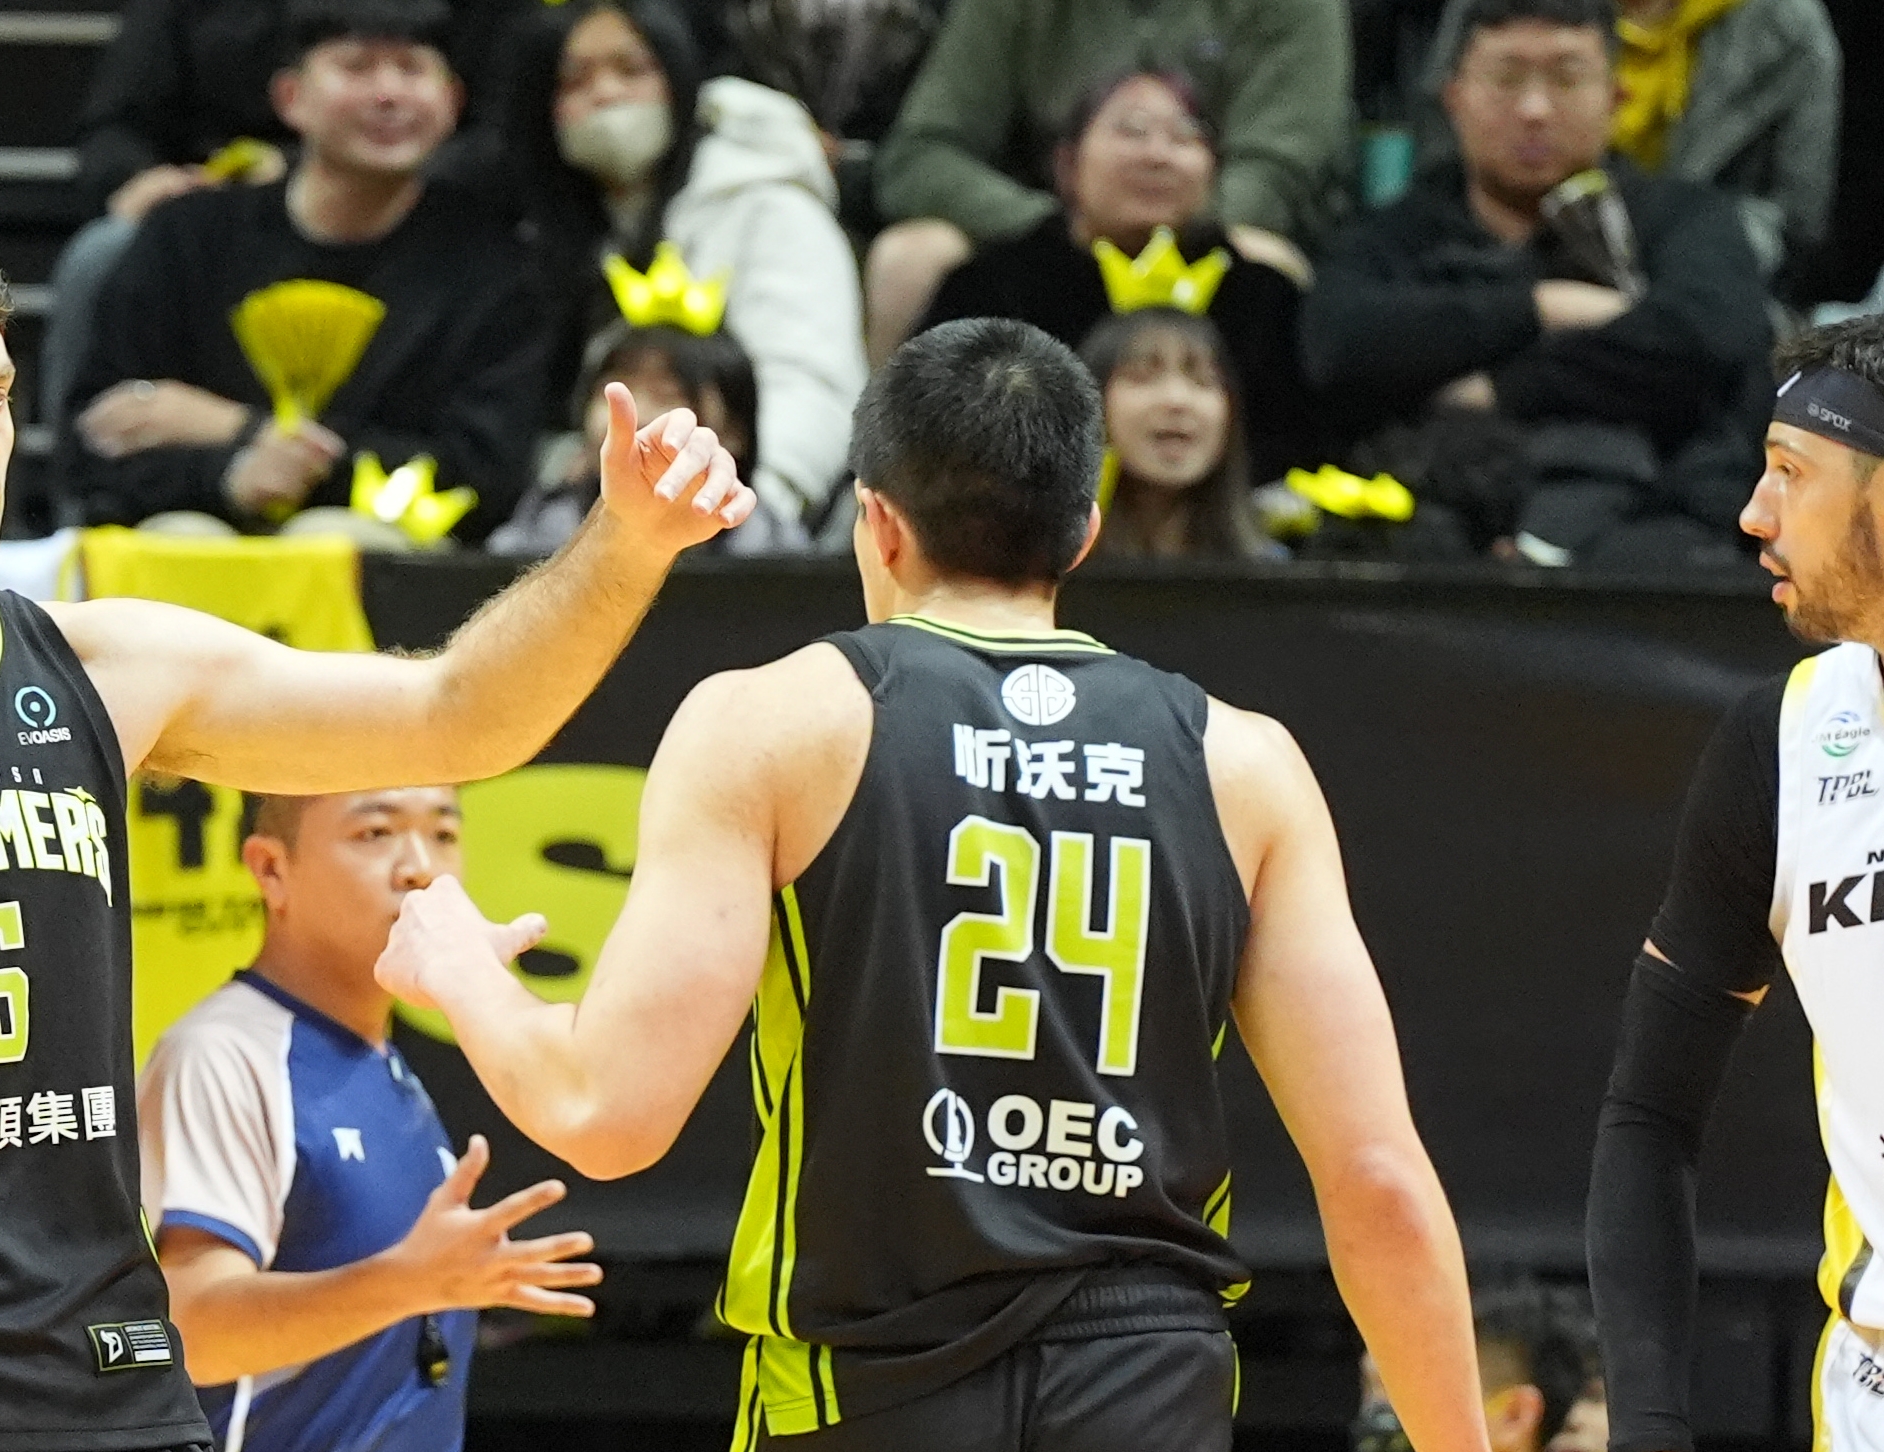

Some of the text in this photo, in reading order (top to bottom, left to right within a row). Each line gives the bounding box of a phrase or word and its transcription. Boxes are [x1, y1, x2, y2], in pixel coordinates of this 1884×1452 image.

[17, 727, 72, 746] EVOASIS
[1817, 769, 1880, 806] TPBL
[934, 814, 1152, 1078] 24
[987, 1093, 1145, 1163] OEC
[986, 1152, 1145, 1199] GROUP
